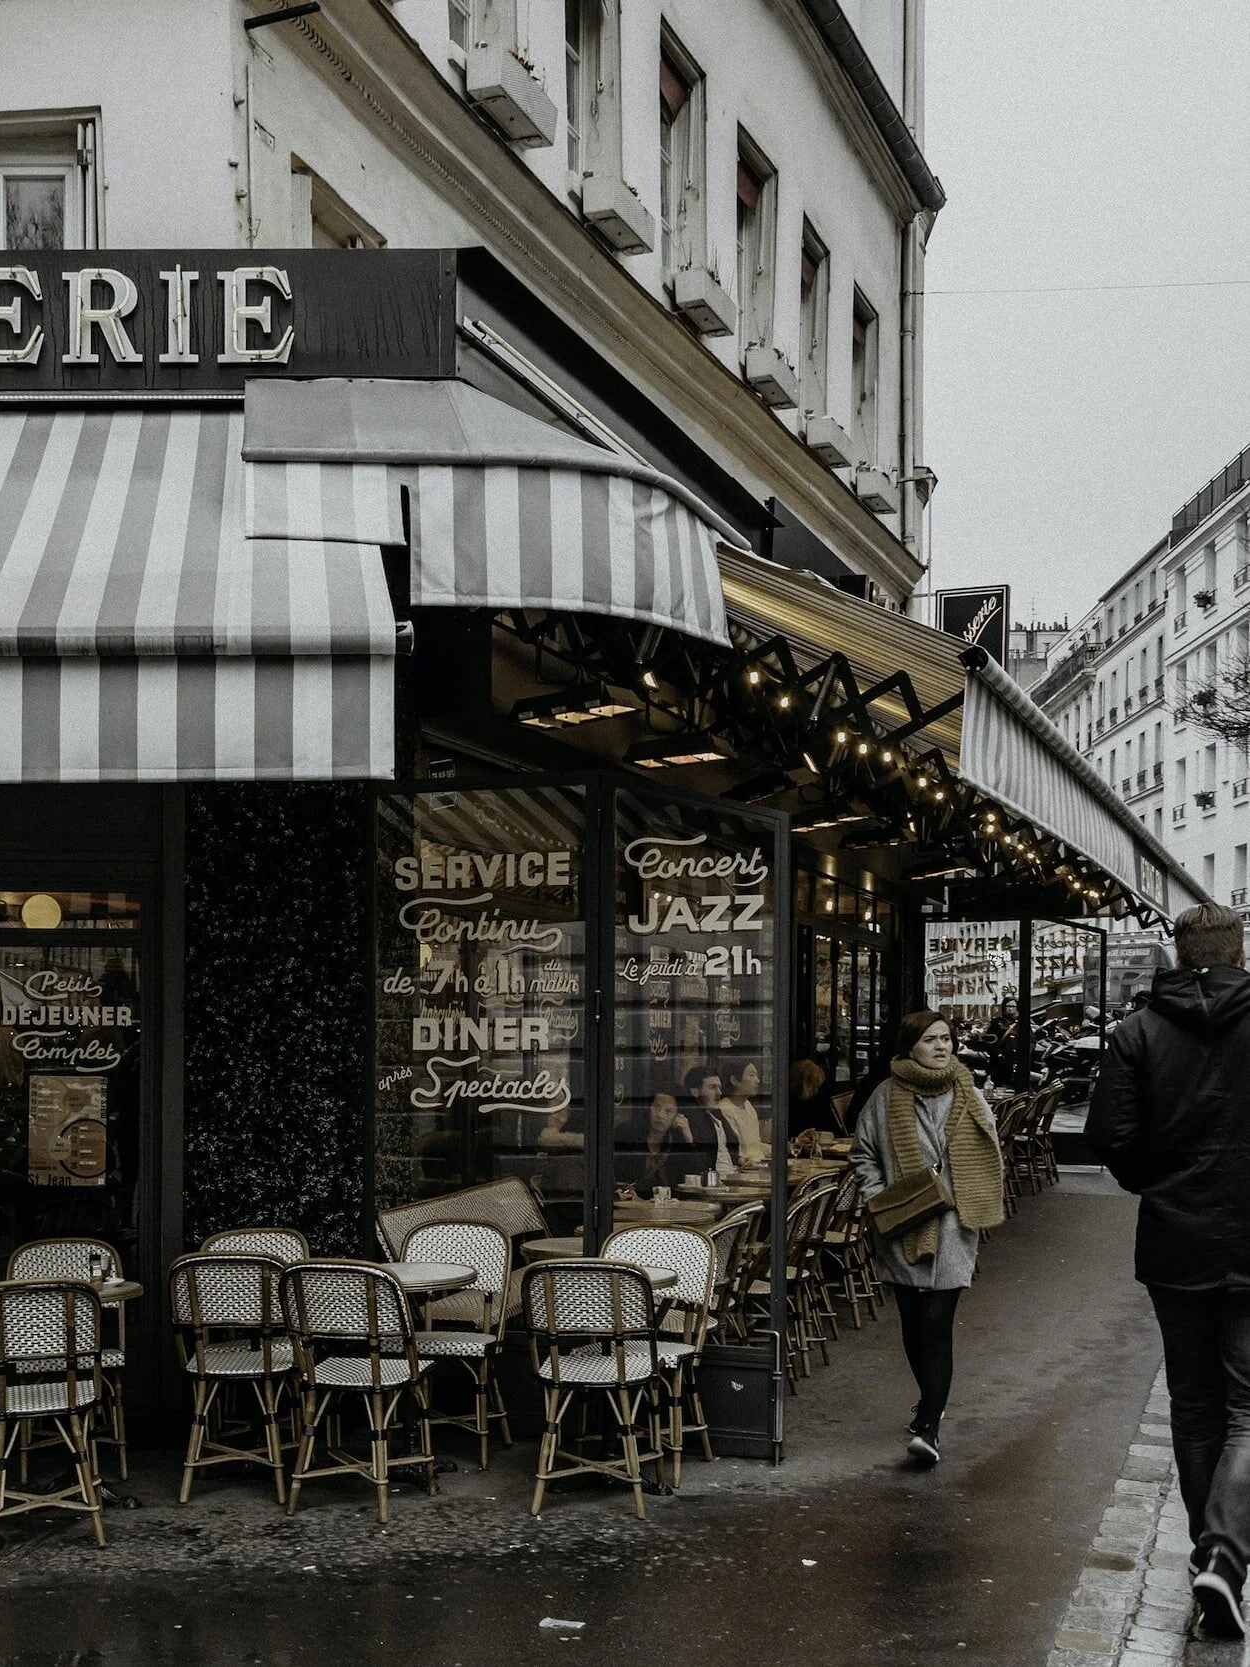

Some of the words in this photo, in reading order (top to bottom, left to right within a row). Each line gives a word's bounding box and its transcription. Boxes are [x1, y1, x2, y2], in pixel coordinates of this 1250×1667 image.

[963, 596, 997, 643] sserie
[395, 852, 571, 891] SERVICE
[624, 834, 769, 887] Concert
[398, 892, 563, 955] Continu
[629, 894, 765, 934] JAZZ
[383, 967, 416, 995] de
[420, 960, 468, 995] 7h
[529, 976, 578, 994] matin
[544, 959, 563, 972] du
[618, 957, 639, 982] Le
[639, 957, 682, 986] jeudi
[704, 946, 762, 976] 21h
[23, 970, 103, 1001] Petit
[12, 1029, 121, 1073] Complet
[412, 1017, 550, 1051] DINER
[378, 1065, 413, 1091] après
[410, 1056, 572, 1113] Spectacles
